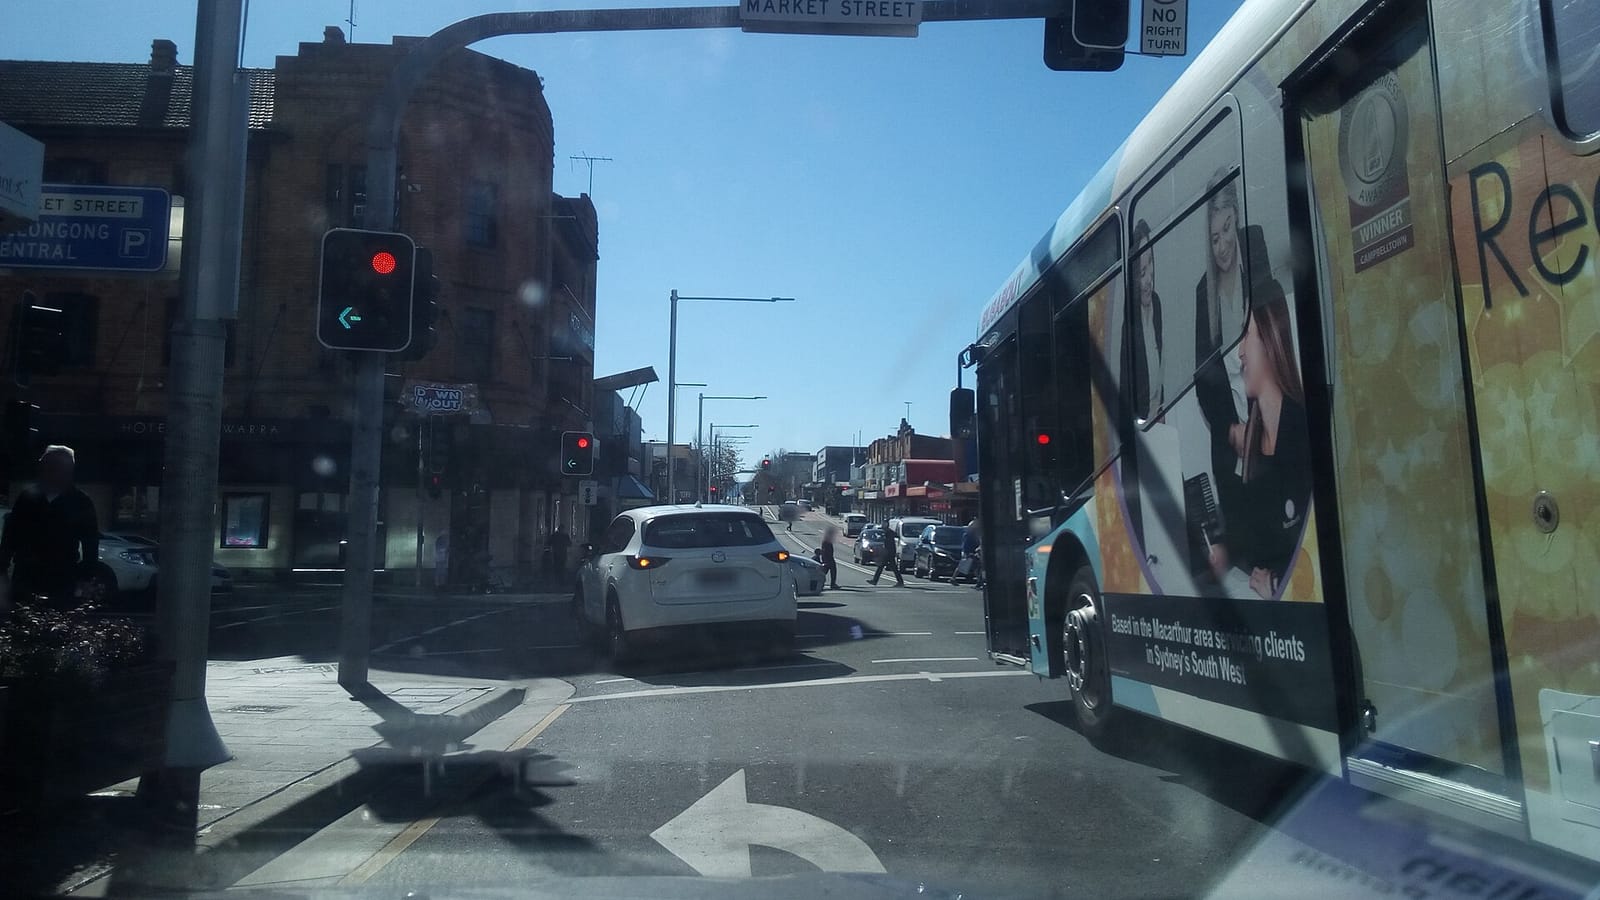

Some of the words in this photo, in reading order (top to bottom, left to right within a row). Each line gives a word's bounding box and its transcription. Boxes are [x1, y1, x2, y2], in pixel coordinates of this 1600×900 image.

[746, 0, 828, 15] MARKET
[841, 1, 916, 18] STREET
[1152, 8, 1177, 22] NO
[1146, 26, 1182, 36] RIGHT
[1147, 39, 1180, 50] TURN
[73, 199, 138, 214] STREET
[9, 222, 110, 240] ONGONG
[1360, 209, 1404, 243] WINNER
[1468, 161, 1600, 310] Re
[0, 241, 77, 259] ENTRAL
[416, 388, 460, 400] DWN
[121, 422, 165, 434] HOTE
[223, 424, 278, 433] WARRA
[1111, 613, 1132, 635] Based
[1132, 616, 1140, 636] in
[1140, 617, 1152, 638] the
[1152, 618, 1192, 644] Macarthur
[1193, 628, 1214, 648] area
[1264, 630, 1306, 662] clients
[1145, 642, 1154, 664] in
[1154, 644, 1191, 676] Sydney's
[1191, 650, 1219, 679] South
